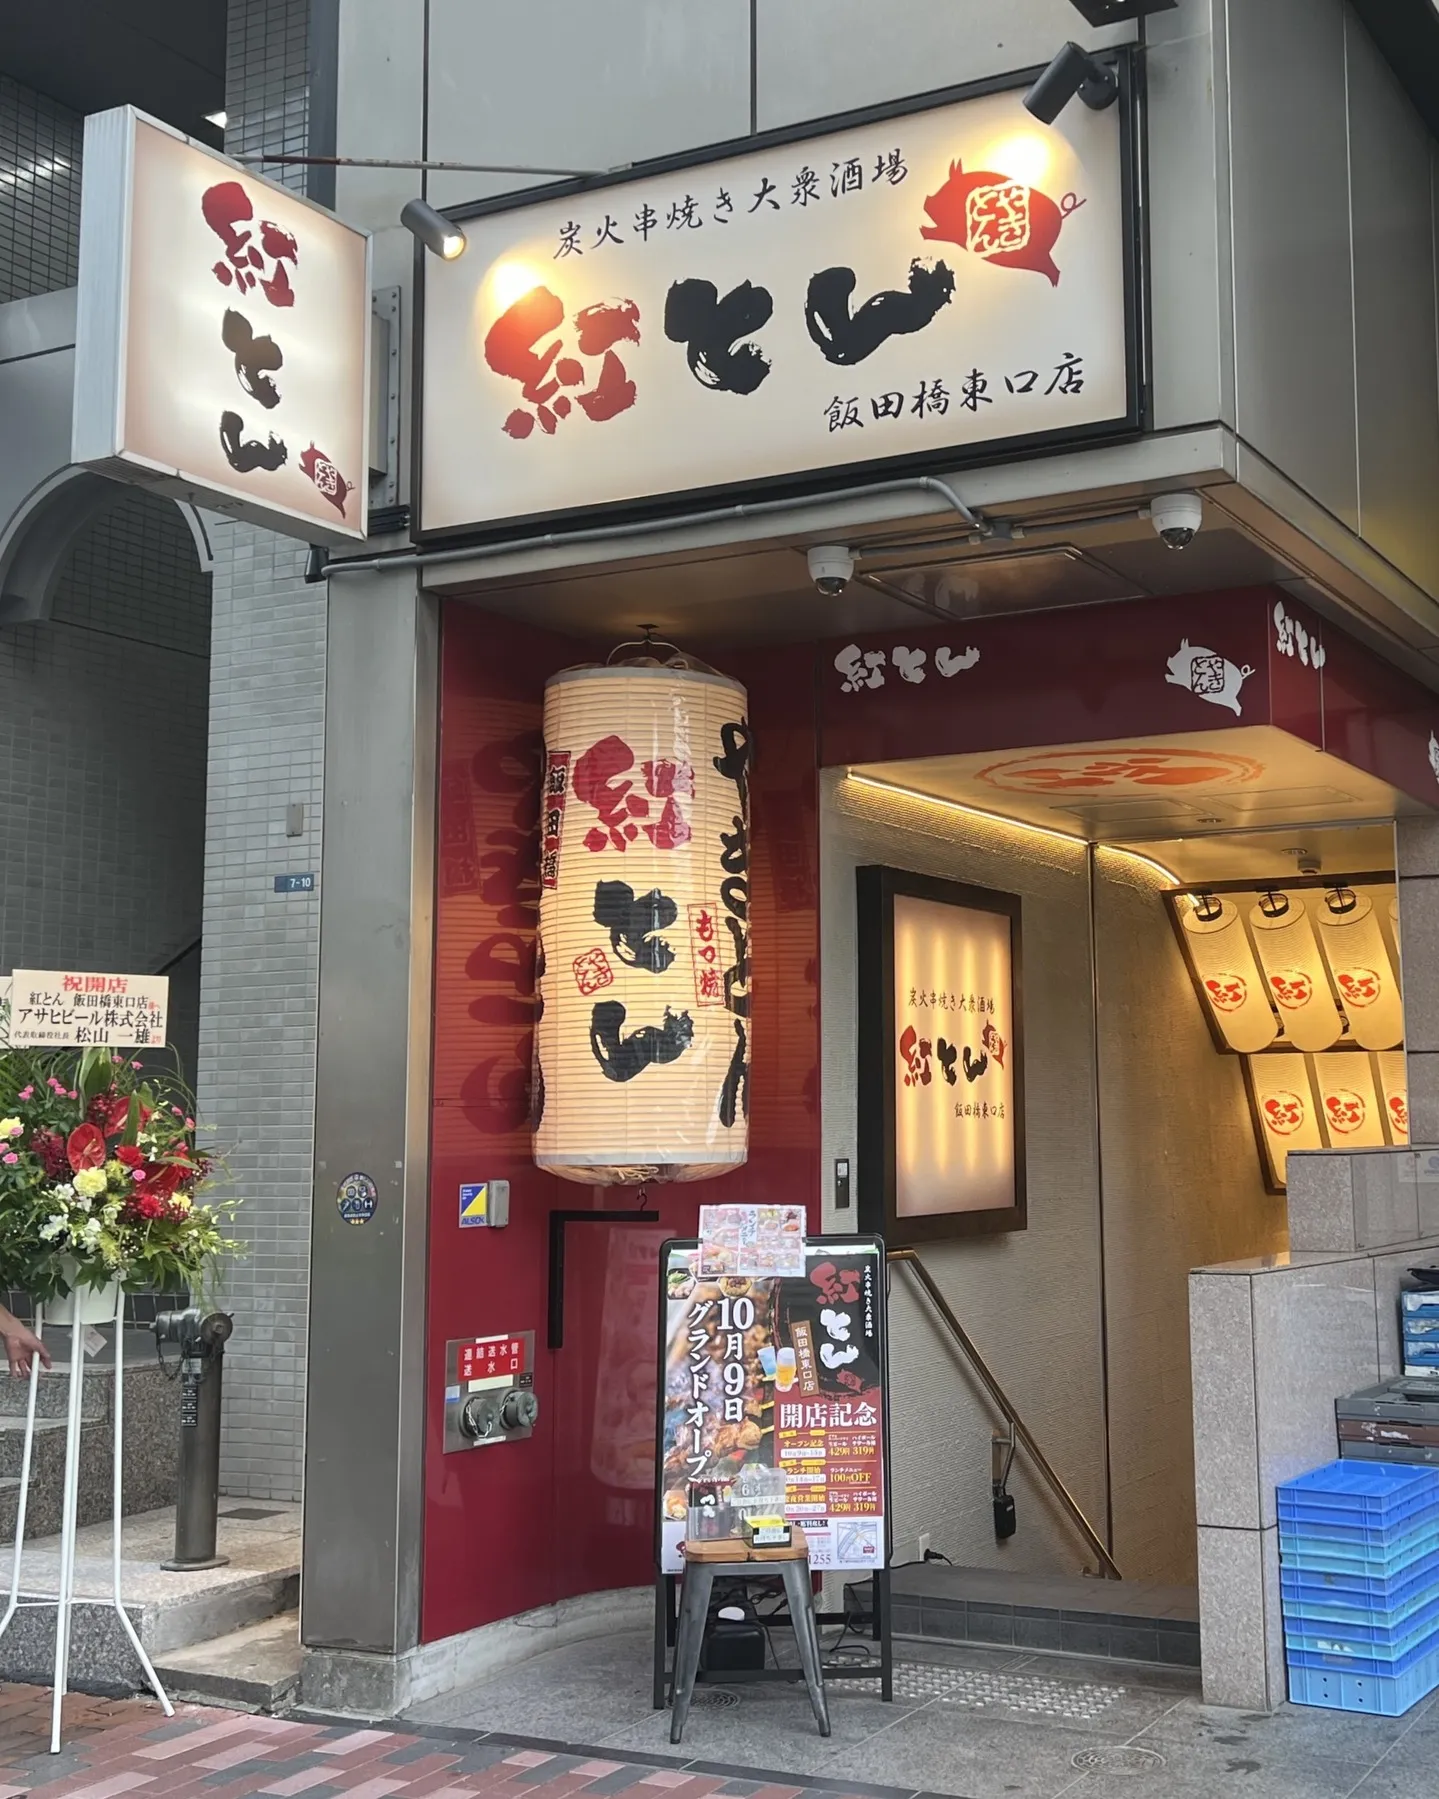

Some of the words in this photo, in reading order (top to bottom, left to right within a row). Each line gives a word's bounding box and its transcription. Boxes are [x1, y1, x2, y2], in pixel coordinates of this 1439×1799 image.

[201, 181, 298, 474] 紅とん
[484, 255, 956, 440] 紅とん
[823, 352, 1084, 432] 飯田橋東口店
[834, 644, 981, 693] 紅とん
[290, 877, 311, 888] 7-10
[29, 991, 64, 1007] 紅とん
[73, 993, 149, 1010] 飯田橋東口店
[63, 974, 128, 994] 祝開店
[18, 1008, 163, 1029] アサヒビール株式会社
[75, 1026, 109, 1044] 松山
[117, 1028, 150, 1045] 一雄
[900, 1025, 988, 1087] 紅とん
[955, 1102, 1005, 1119] 飯田橋東口店
[810, 1261, 860, 1369] 紅とん
[717, 1297, 755, 1422] 10月9日
[795, 1326, 815, 1391] 飯田橋東口店
[780, 1402, 877, 1429] 開店記念
